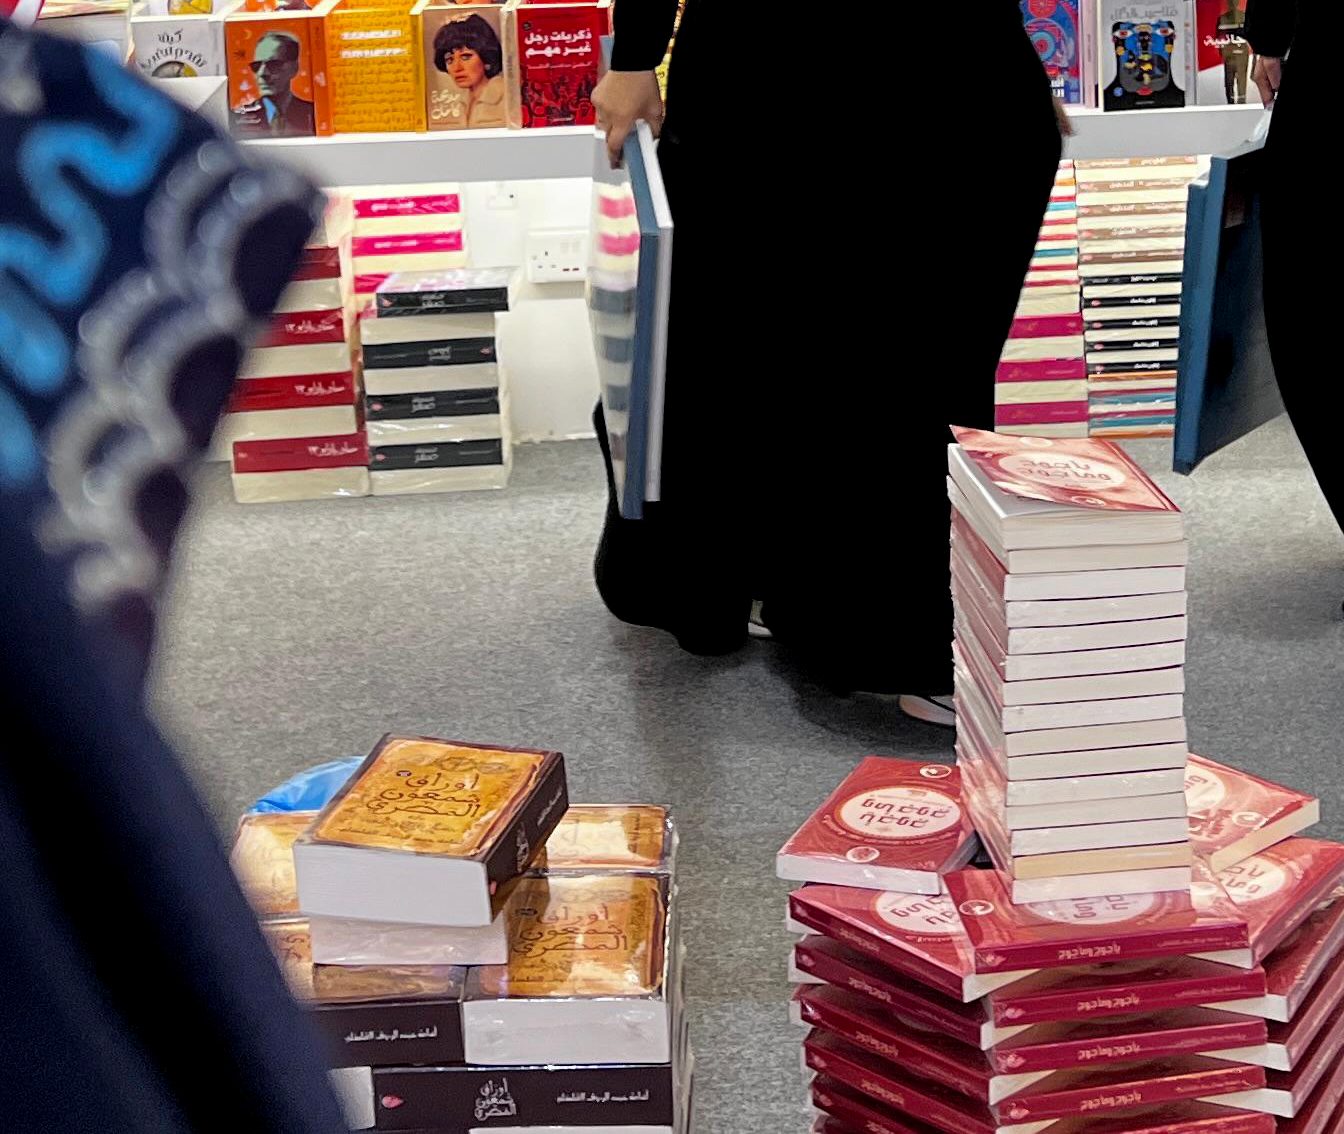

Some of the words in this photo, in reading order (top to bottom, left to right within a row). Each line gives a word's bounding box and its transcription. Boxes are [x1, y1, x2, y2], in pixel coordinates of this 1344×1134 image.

[524, 29, 549, 45] رجل
[549, 27, 593, 43] ذكريات
[380, 787, 481, 804] شمعون
[366, 799, 481, 818] المصري
[519, 920, 625, 942] شمعون
[512, 935, 628, 958] المصري
[473, 1103, 517, 1122] المصري
